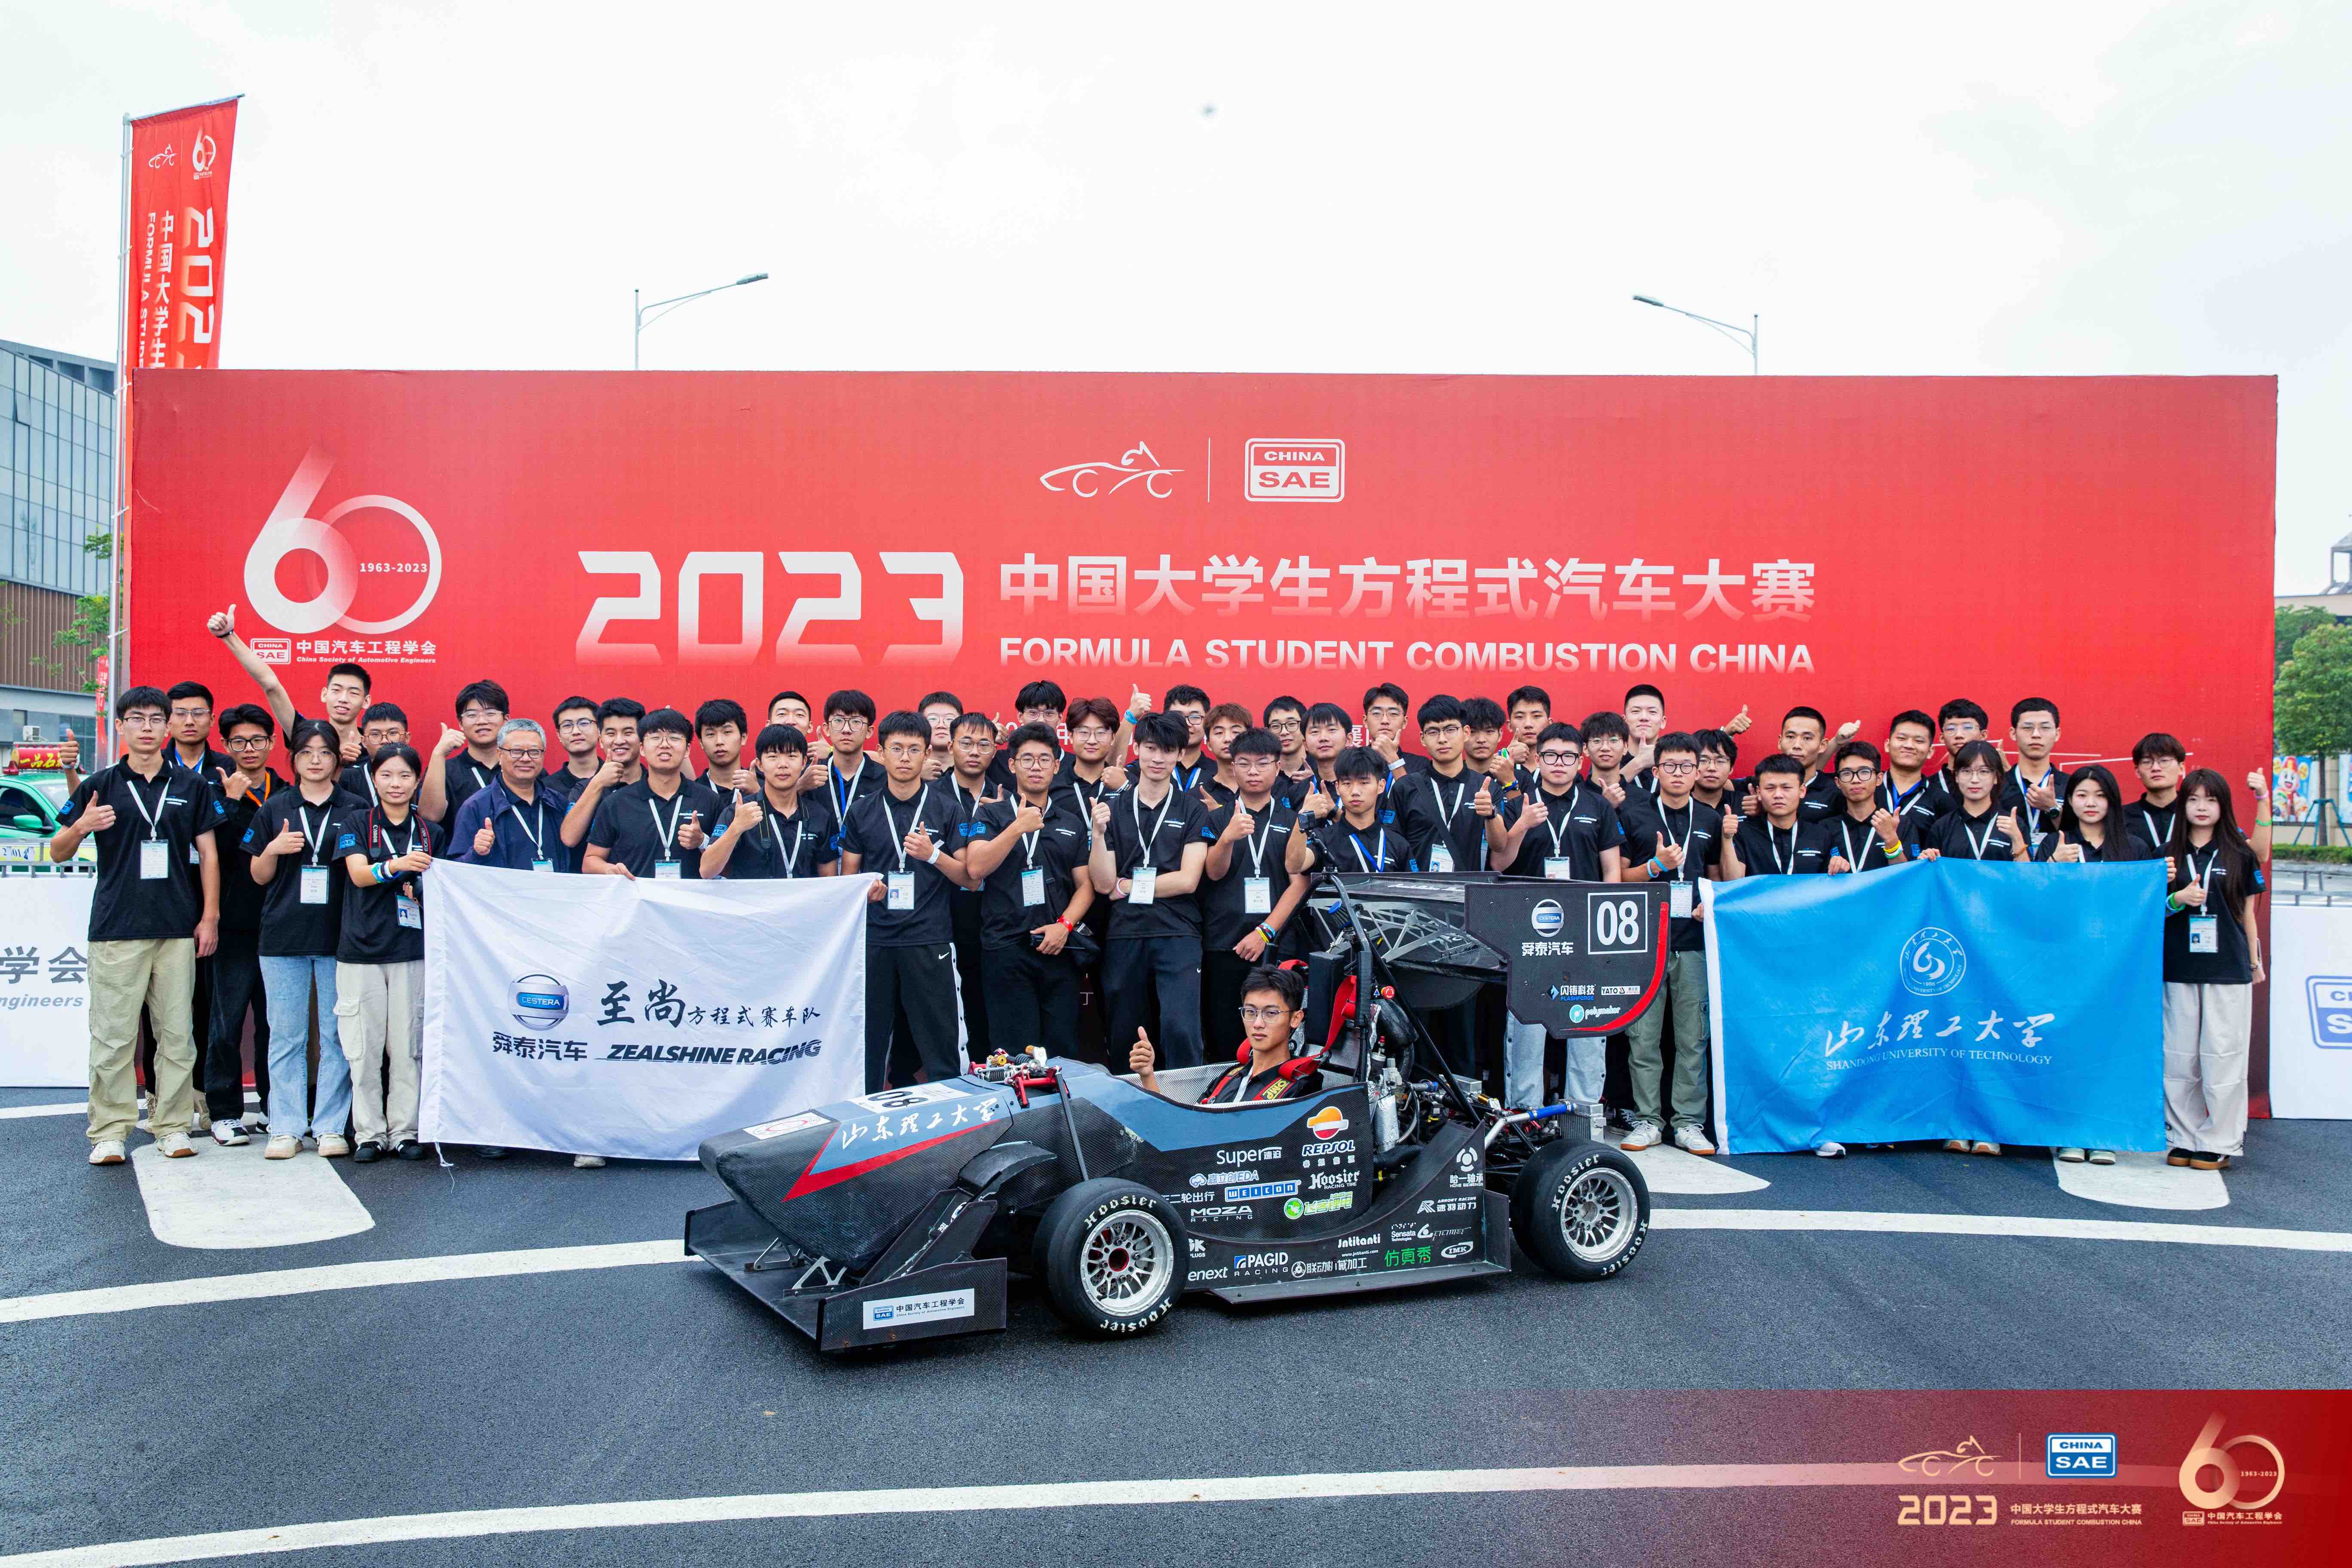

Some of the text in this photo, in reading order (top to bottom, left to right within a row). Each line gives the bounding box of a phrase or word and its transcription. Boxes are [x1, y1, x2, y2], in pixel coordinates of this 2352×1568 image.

[176, 206, 214, 368] 202
[1264, 451, 1325, 461] CHINA
[1258, 471, 1330, 488] SAE
[360, 562, 428, 573] 1963-2023
[1000, 552, 1815, 622] 中国大学生方程式汽车大赛
[576, 551, 964, 665] 2023
[296, 639, 436, 655] 中国汽车工程学会
[1000, 637, 1815, 674] FORMULA STUDENT COMBUSTION CHINA
[20, 753, 62, 768] 一品石
[1596, 900, 1639, 946] 08
[1522, 942, 1574, 956] 舜泰汽车
[0, 946, 87, 984] 学会
[0, 993, 83, 1011] ngineers
[522, 997, 560, 1006] CESTERA
[1585, 1005, 1620, 1020] polymaker
[1824, 1009, 2055, 1057] 山东理工大学
[492, 1031, 588, 1062] 舜泰汽车
[605, 1039, 822, 1066] ZEALSHINE RACING
[1826, 1047, 2053, 1071] SHANDONG UNIVERSITY OF TECHNOLOGY
[1266, 1079, 1287, 1100] OMP
[867, 1091, 929, 1108] 08
[842, 1097, 998, 1150] 山东理工大学
[1216, 1148, 1266, 1167] Super
[1302, 1140, 1356, 1156] REPSOL
[1207, 1170, 1259, 1185] 嘉立创EDA
[1308, 1169, 1360, 1189] Hoosier
[1551, 1154, 1599, 1212] Hoosier
[1084, 1194, 1157, 1228] Hoosier
[1190, 1205, 1253, 1216] MOZA
[1391, 1230, 1416, 1238] Sensata
[1341, 1249, 1379, 1257] www.jntitanti.com
[1384, 1245, 1431, 1267] 仿真秀
[1601, 1219, 1648, 1276] Hoosier
[1248, 1252, 1289, 1268] PAGID
[1234, 1267, 1289, 1277] RACING
[896, 1297, 965, 1312] 中国汽车工程学会
[1100, 1296, 1173, 1332] Hoosier
